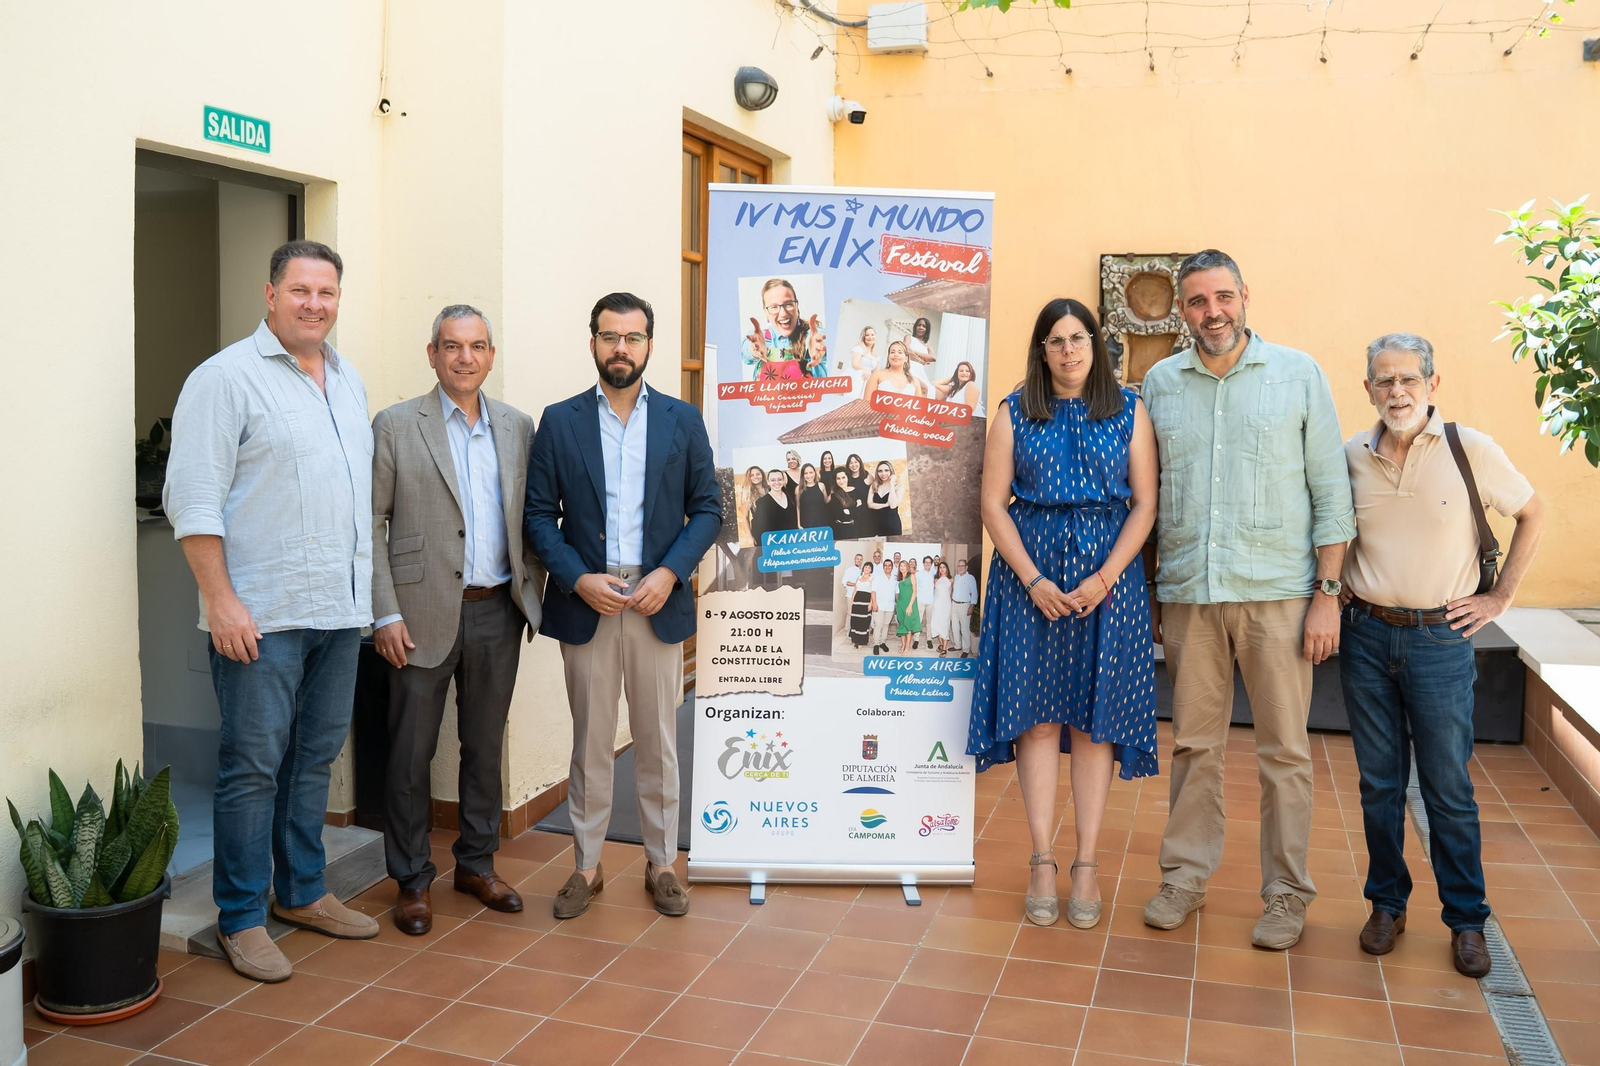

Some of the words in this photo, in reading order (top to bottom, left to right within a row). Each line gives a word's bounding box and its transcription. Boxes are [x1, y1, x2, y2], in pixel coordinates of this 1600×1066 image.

[208, 112, 266, 148] SALIDA
[735, 201, 773, 228] IV
[886, 244, 984, 274] Festival
[720, 385, 736, 396] YO
[740, 383, 756, 393] ME
[760, 381, 798, 392] LLAMO
[802, 378, 848, 389] CHACHA
[769, 400, 804, 412] Infantil
[875, 394, 922, 410] VOCAL
[926, 403, 968, 418] VIDAS
[905, 414, 936, 427] (Cuba)
[923, 432, 954, 442] vocal
[766, 530, 828, 546] KANARII
[763, 556, 838, 568] Hispanoamericana
[729, 610, 774, 620] AGOSTO
[776, 610, 800, 621] 2025
[730, 628, 762, 638] 21:00
[766, 628, 773, 638] H
[720, 644, 753, 654] PLAZA
[755, 645, 768, 654] DE
[770, 645, 783, 654] LA
[712, 656, 790, 666] CONSTITUCIÓN
[868, 659, 924, 671] NUEVOS
[929, 660, 972, 672] AIRES
[921, 688, 950, 697] Latina
[705, 706, 785, 722] Organizan:
[856, 708, 906, 717] Colaboran:
[718, 736, 794, 782] Enix
[842, 764, 898, 774] DIPUTACIÓN
[842, 774, 854, 782] DE
[856, 772, 896, 783] ALMERÍA
[750, 801, 818, 813] NUEVOS
[762, 817, 809, 828] AIRES
